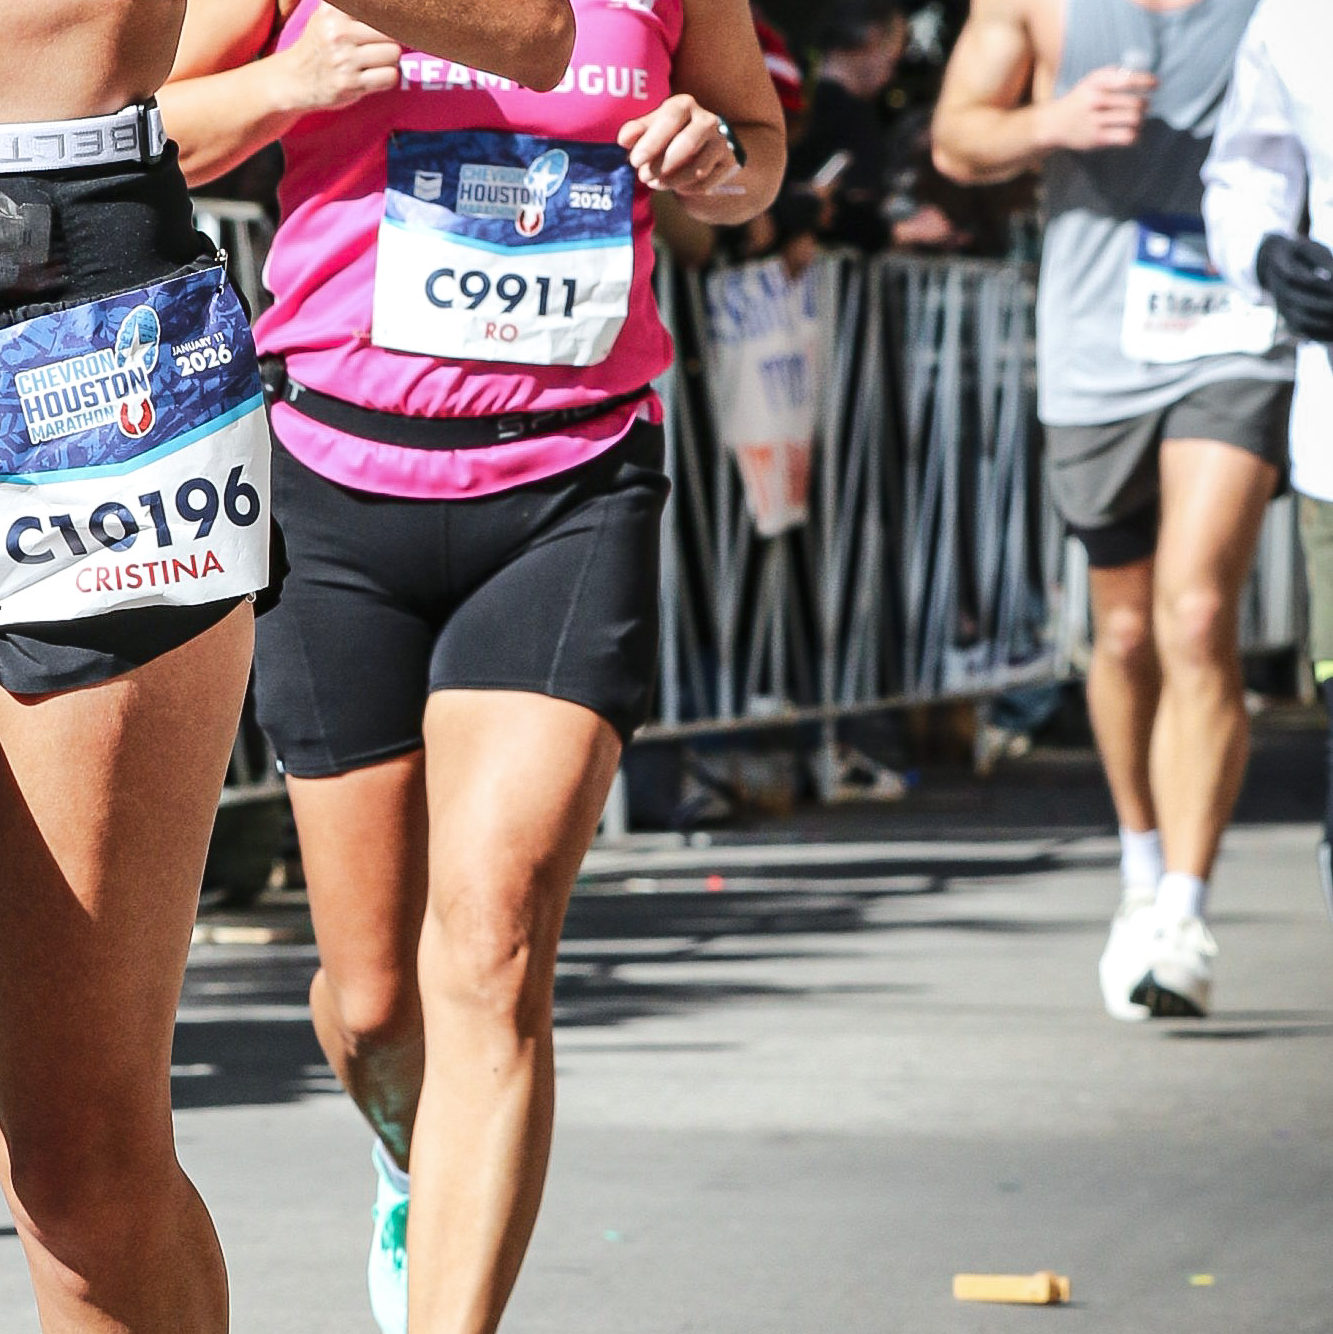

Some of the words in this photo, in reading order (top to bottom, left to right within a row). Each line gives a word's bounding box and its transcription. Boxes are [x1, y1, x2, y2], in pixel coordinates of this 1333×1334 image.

[399, 60, 511, 91] TEAM
[460, 183, 543, 205] HOUSTON
[569, 191, 612, 211] 2026
[425, 268, 577, 318] C9911
[171, 336, 211, 356] JANUARY
[213, 331, 225, 343] 11
[485, 323, 518, 343] RO
[17, 351, 115, 395] CHEVRON
[175, 343, 232, 377] 2026
[23, 367, 148, 424] HOUSTON
[30, 405, 115, 442] MARATHON
[6, 464, 261, 565] C10196
[75, 550, 225, 594] CRISTINA
